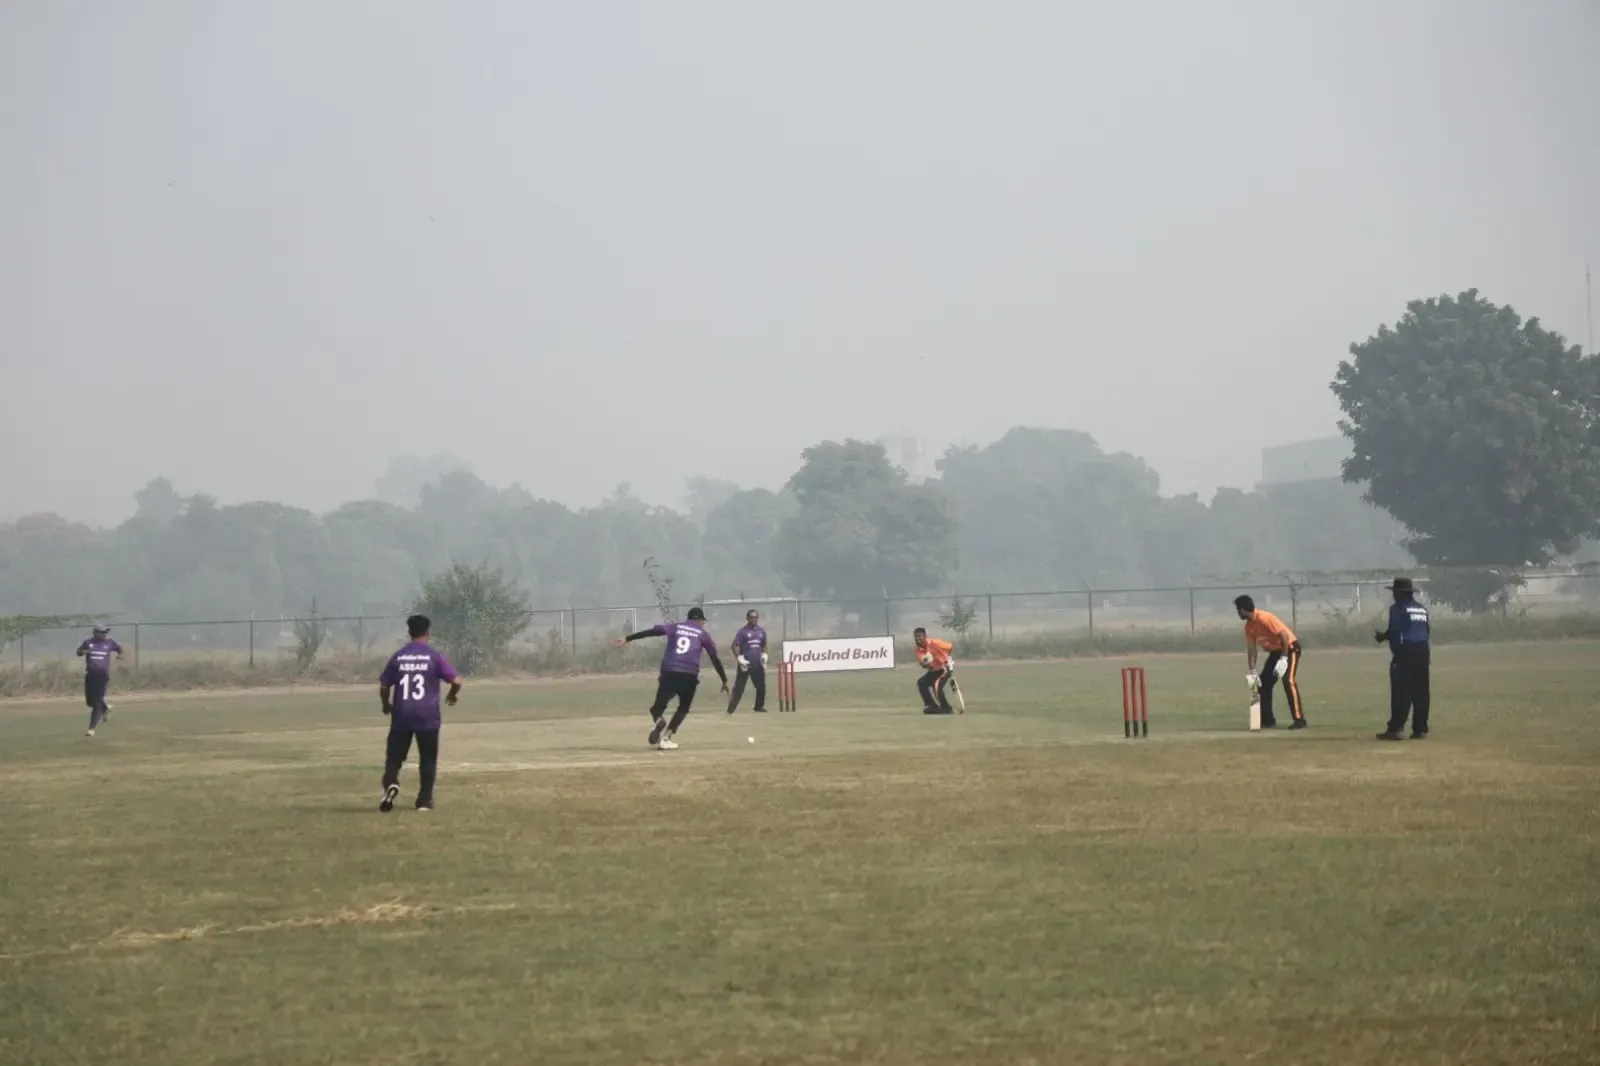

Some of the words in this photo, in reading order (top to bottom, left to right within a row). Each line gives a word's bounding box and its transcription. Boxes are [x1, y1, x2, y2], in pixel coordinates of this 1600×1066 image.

[676, 636, 690, 654] 9
[789, 648, 851, 663] IndusInd
[852, 646, 888, 660] Bank
[399, 663, 428, 671] ASSAM
[400, 674, 425, 700] 13
